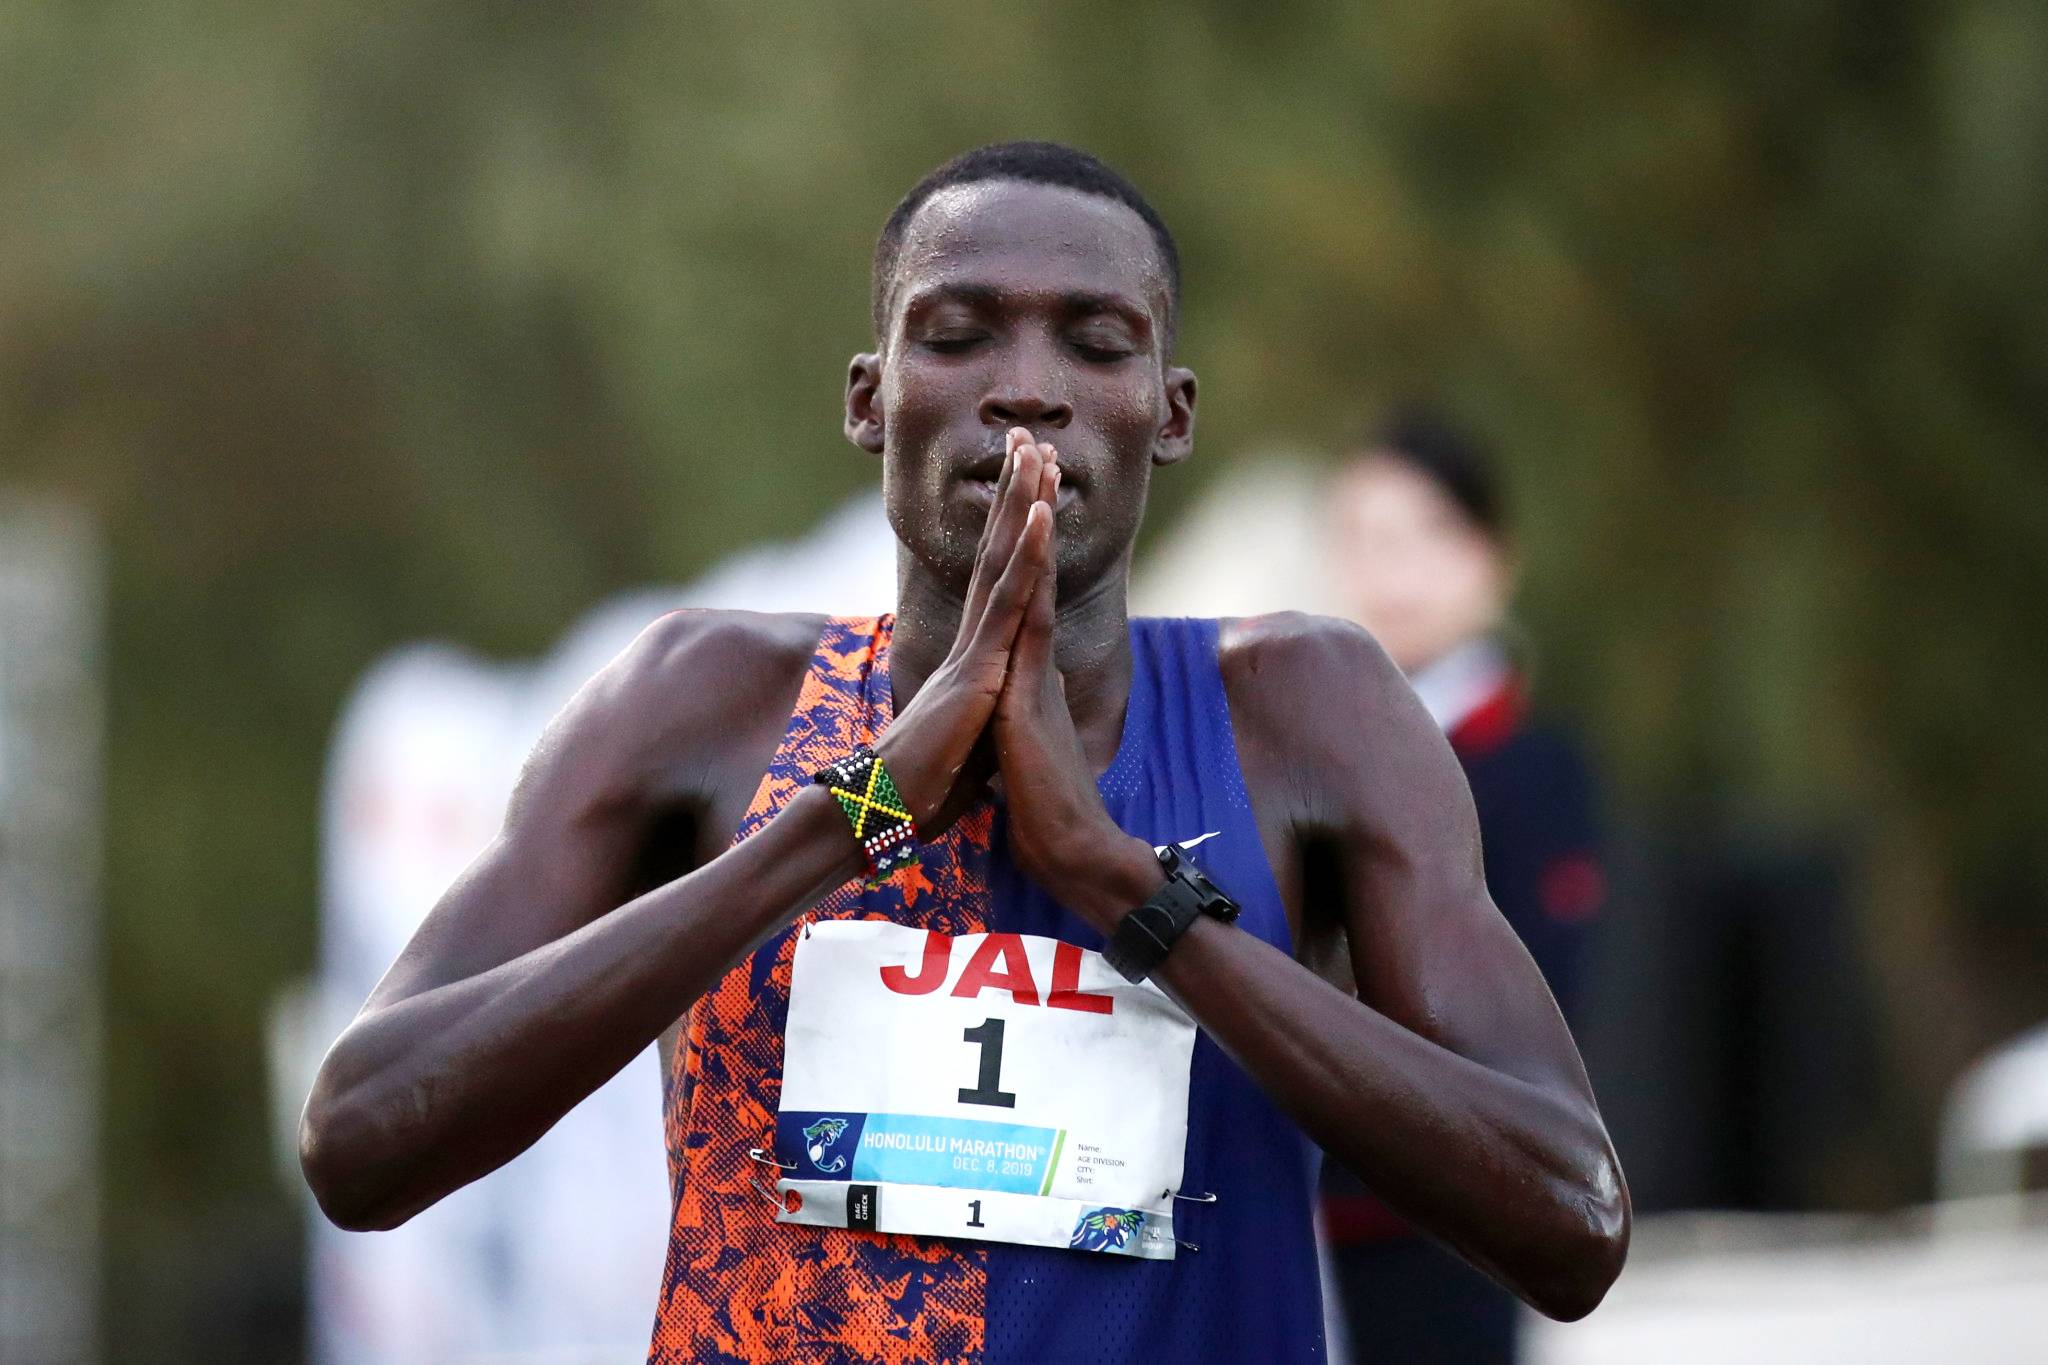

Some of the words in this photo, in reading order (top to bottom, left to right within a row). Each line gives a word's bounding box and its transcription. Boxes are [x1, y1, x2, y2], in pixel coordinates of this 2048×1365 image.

[880, 930, 1114, 1015] JAL
[957, 1018, 1016, 1109] 1
[864, 1132, 946, 1153] HONOLULU
[987, 1159, 999, 1176] 8,
[1002, 1161, 1033, 1177] 2019
[1078, 1155, 1091, 1163] AGE
[861, 1194, 869, 1220] CHECK
[966, 1200, 985, 1228] 1
